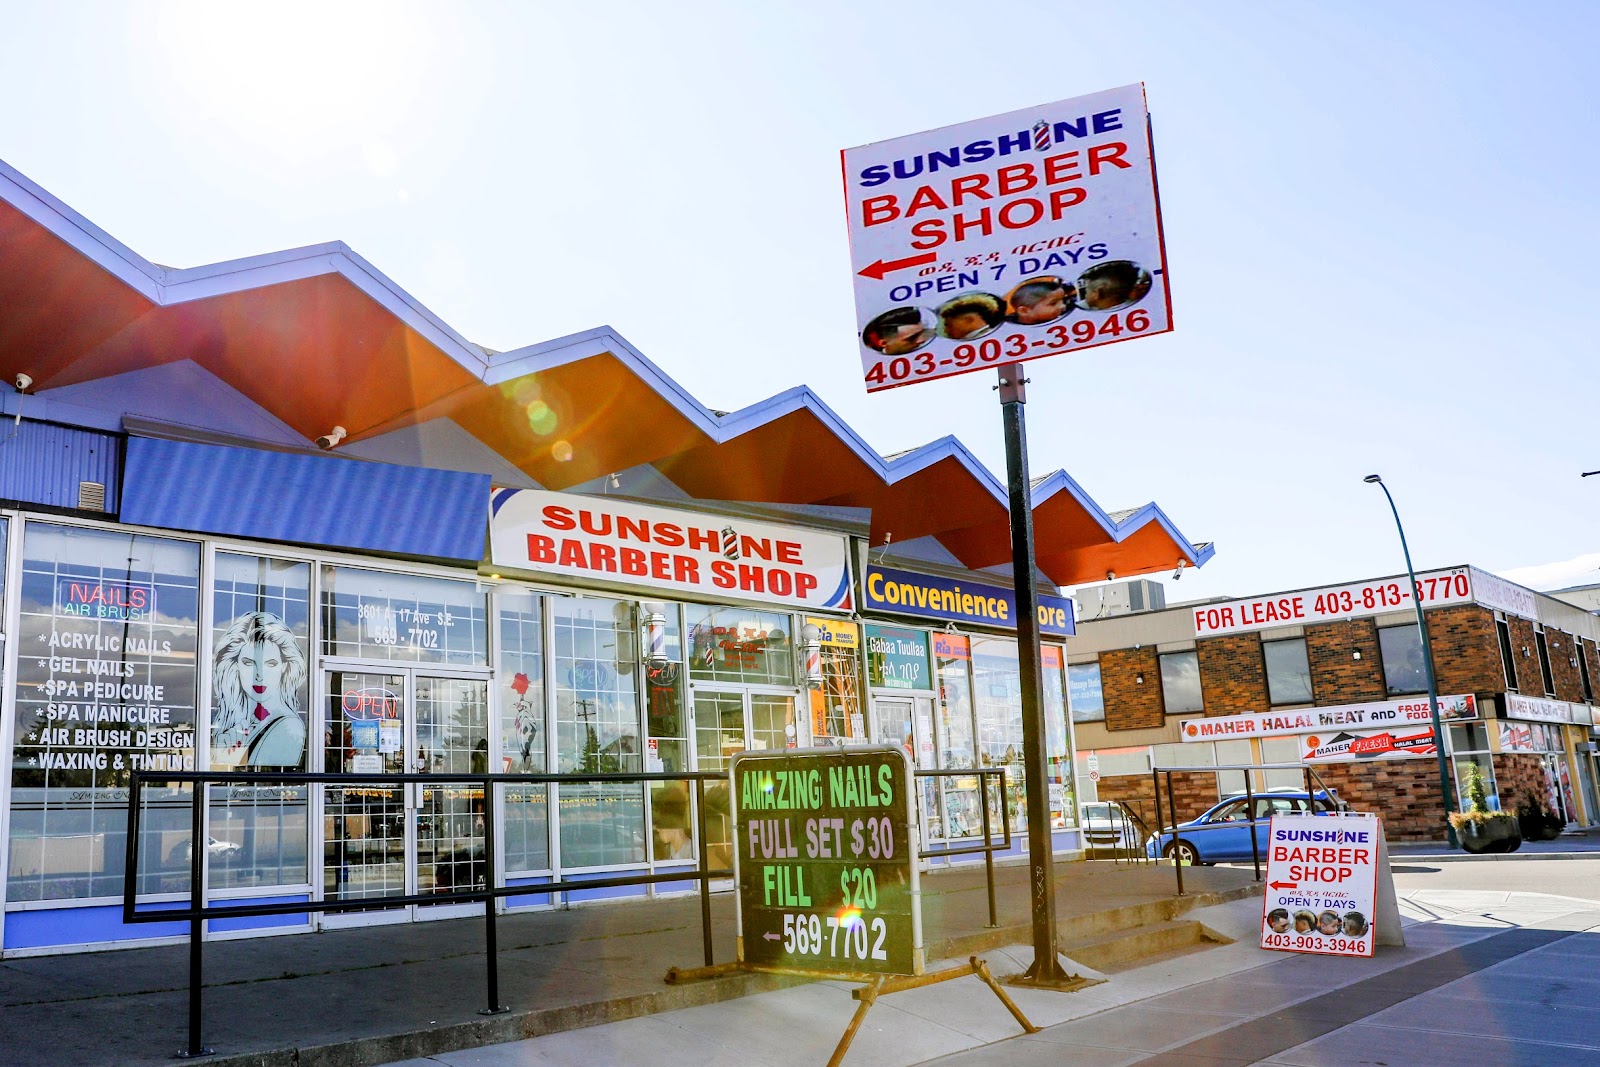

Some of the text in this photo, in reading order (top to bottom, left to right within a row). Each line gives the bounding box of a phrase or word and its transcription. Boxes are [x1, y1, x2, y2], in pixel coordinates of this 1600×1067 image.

[862, 142, 1132, 227] BARBER
[911, 187, 1088, 250] SHOP
[889, 243, 1109, 303] OPEN 7 DAYS
[865, 308, 1150, 384] 403-903-3946
[526, 533, 818, 599] BARBER SHOP
[70, 583, 147, 607] NAILS
[867, 572, 1066, 628] Convenience ore
[64, 602, 152, 620] AIR BRUSH
[357, 604, 381, 620] 3601
[400, 609, 410, 622] 17
[413, 611, 430, 625] Ave
[1195, 606, 1235, 631] FOR
[1241, 597, 1305, 625] LEASE
[49, 632, 172, 655] ACRYLIC NAILS
[374, 625, 398, 645] 569
[408, 628, 439, 648] 7702
[935, 638, 951, 655] Ria
[49, 657, 135, 678] GEL NAILS
[45, 680, 164, 701] SPA PEDICURE
[46, 704, 170, 724] SPA MANICURE
[343, 690, 397, 719] OPEN
[1200, 702, 1444, 736] MAHER HALAL MEAT AND FROZN
[40, 728, 194, 749] AIR BRUSH DESIGN
[1316, 743, 1350, 755] MAHER
[1354, 736, 1390, 753] FRESH
[38, 753, 194, 771] WAXING & TINTING
[742, 764, 893, 810] AMAZING NAILS
[748, 818, 798, 859] FULL
[805, 818, 844, 859] SET
[1274, 846, 1369, 865] BARBER
[1289, 865, 1352, 883] SHOP
[763, 865, 877, 910] FILL $20
[1278, 896, 1356, 909] OPEN 7 DAYS
[1265, 934, 1366, 953] 403-903-3946
